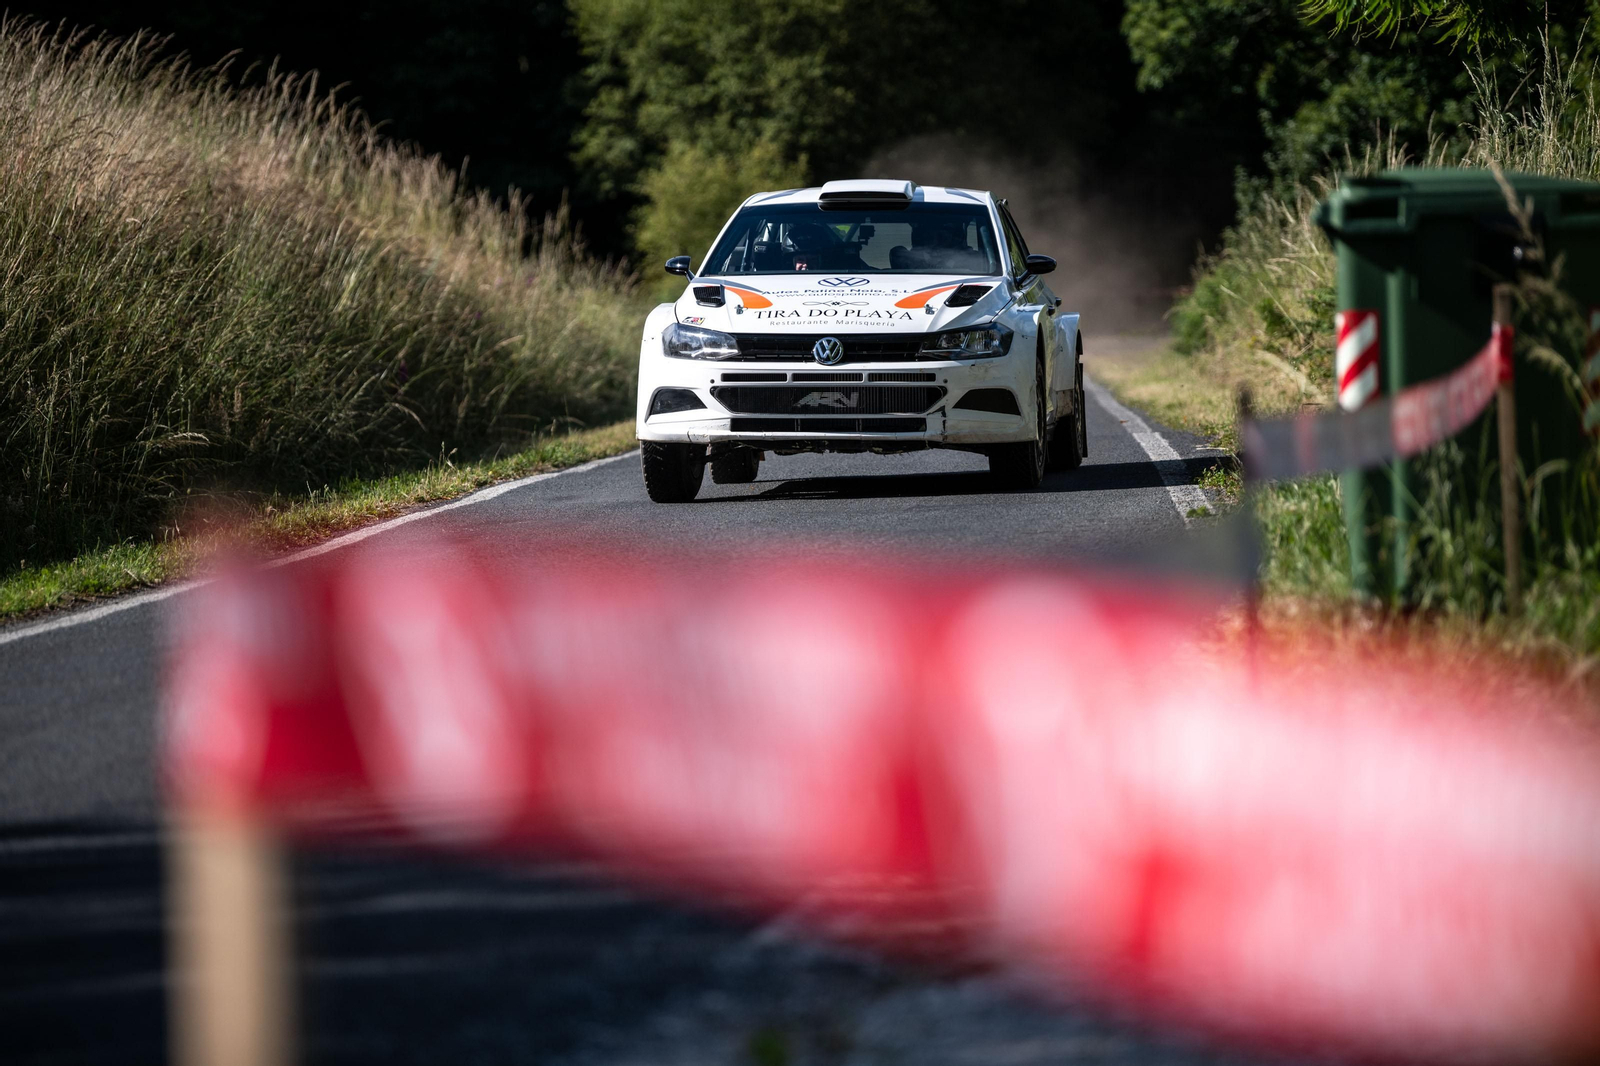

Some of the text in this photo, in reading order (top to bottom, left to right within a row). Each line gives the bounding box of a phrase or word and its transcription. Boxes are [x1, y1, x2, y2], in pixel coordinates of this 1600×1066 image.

[754, 309, 913, 320] TIRA DO PLAYA
